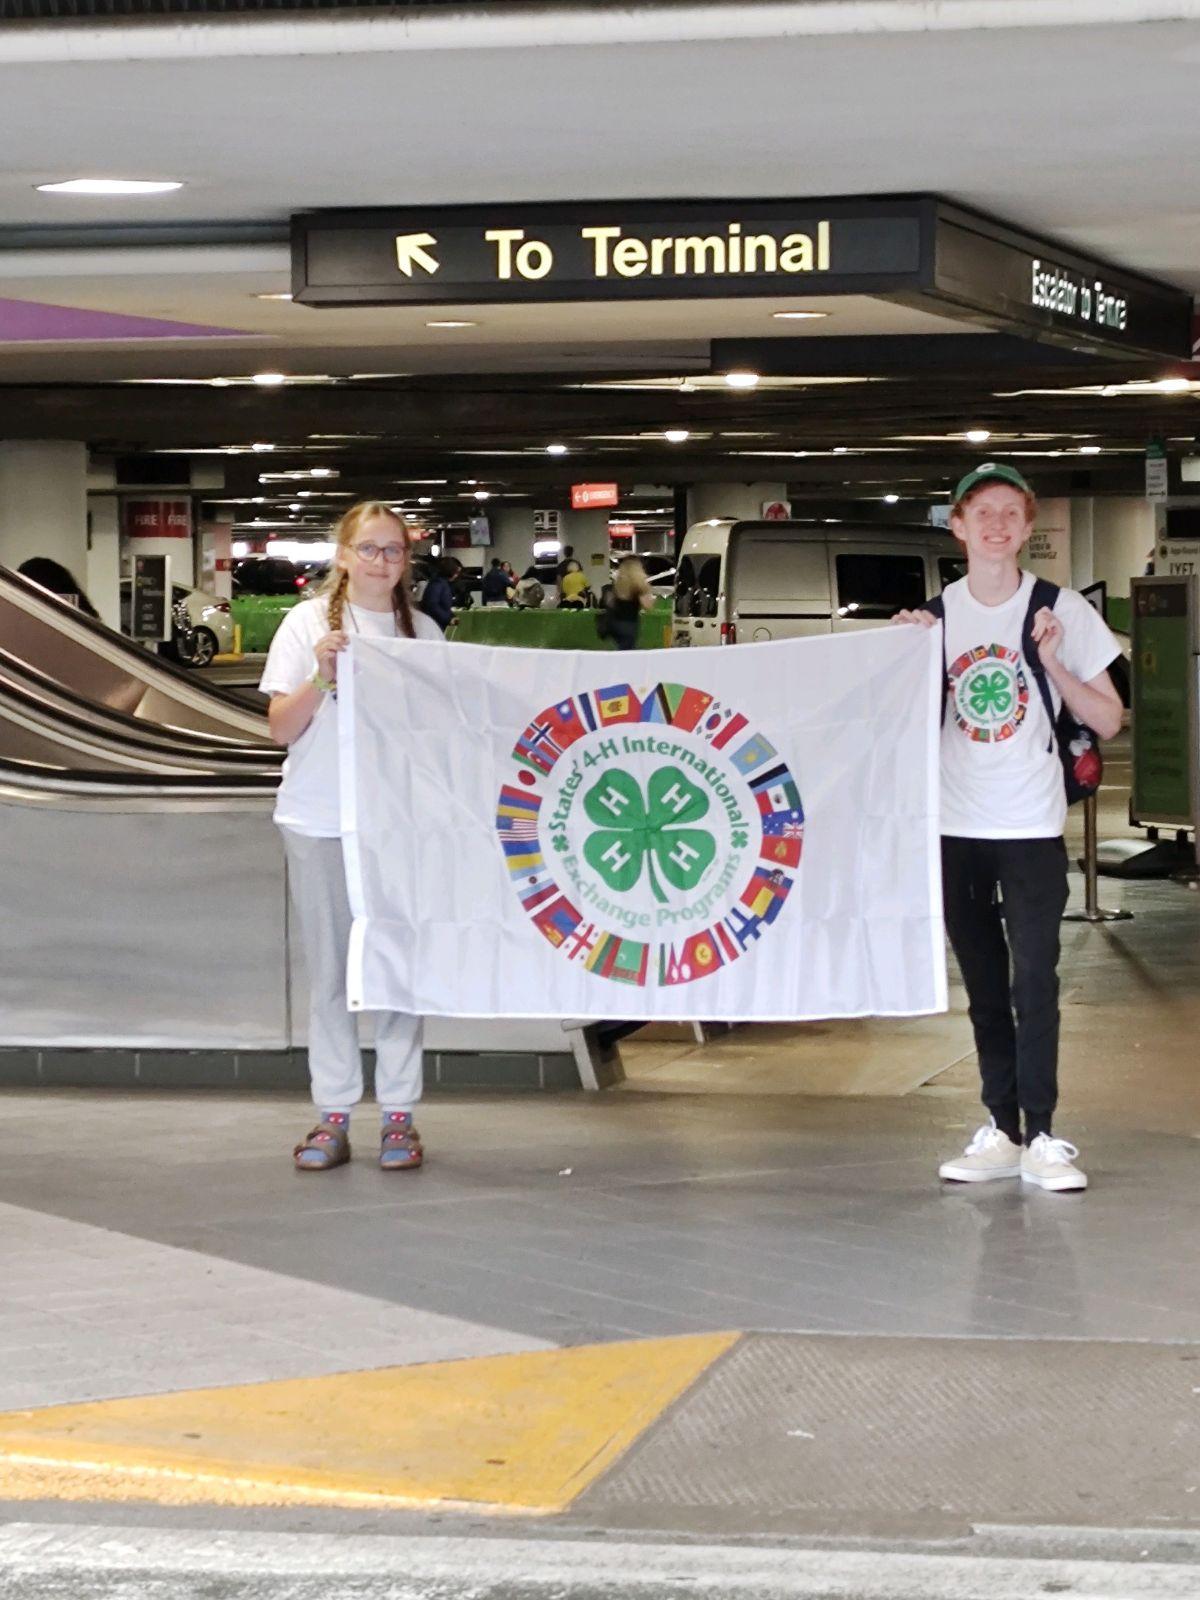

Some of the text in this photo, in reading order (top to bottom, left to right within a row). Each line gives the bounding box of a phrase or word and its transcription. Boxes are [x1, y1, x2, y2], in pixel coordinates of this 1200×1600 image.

[485, 220, 830, 279] To Terminal
[134, 514, 158, 526] FIRE
[167, 514, 188, 526] FIRE
[583, 738, 619, 767] 4-H
[622, 735, 750, 829] International
[660, 782, 692, 814] H
[598, 785, 629, 816] H
[600, 840, 632, 872] H
[668, 840, 700, 872] H
[562, 852, 742, 928] Exchange Programs
